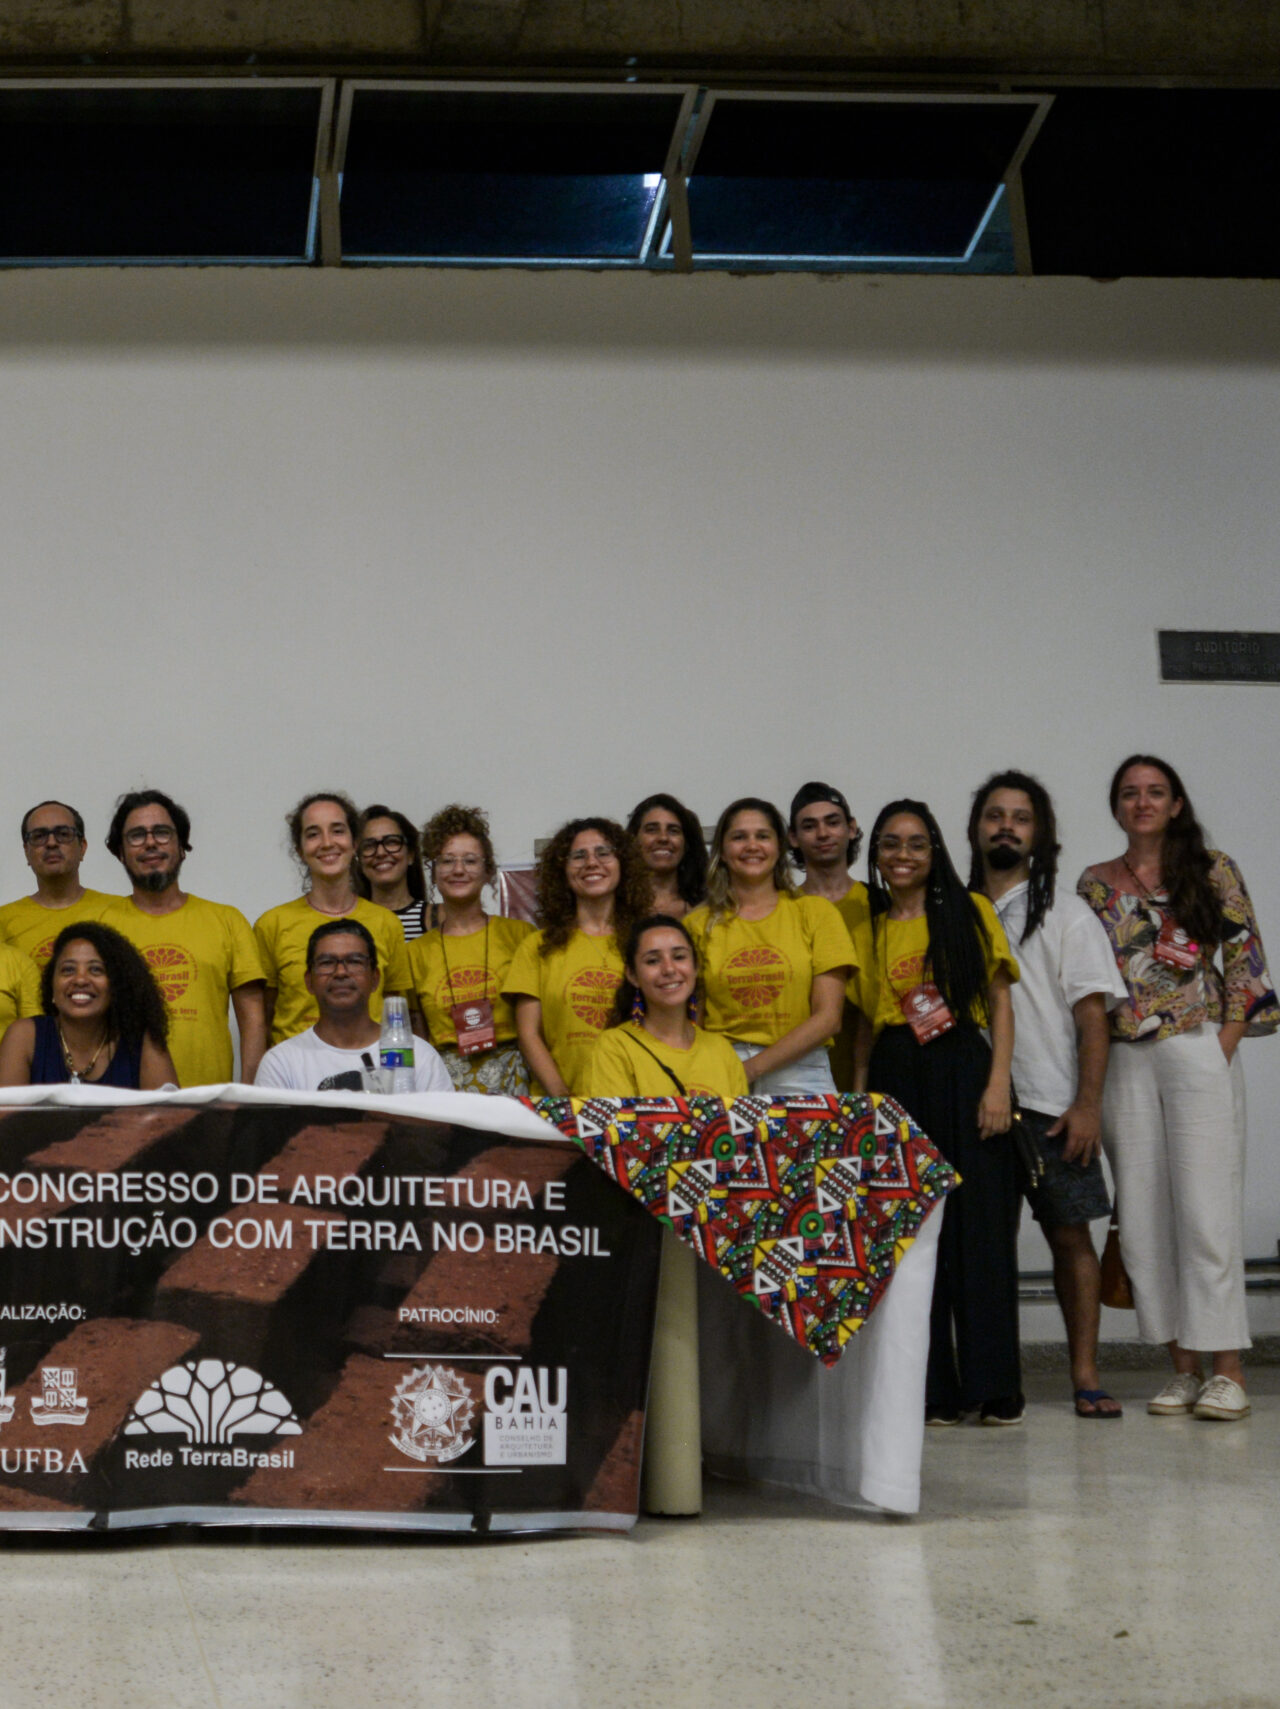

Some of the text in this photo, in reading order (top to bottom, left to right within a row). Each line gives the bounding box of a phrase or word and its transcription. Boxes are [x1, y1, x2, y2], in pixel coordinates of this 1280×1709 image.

[232, 1174, 279, 1203] DE
[289, 1174, 534, 1209] ARQUITETURA
[545, 1182, 566, 1210] E
[209, 1218, 292, 1249] COM
[304, 1220, 422, 1250] TERRA
[434, 1222, 484, 1252] NO
[495, 1224, 610, 1256] BRASIL
[400, 1307, 499, 1323] PATROCÍNIO:
[484, 1366, 567, 1415] CAU
[495, 1417, 558, 1430] BAHIA
[126, 1448, 294, 1468] Rede TerraBrasil
